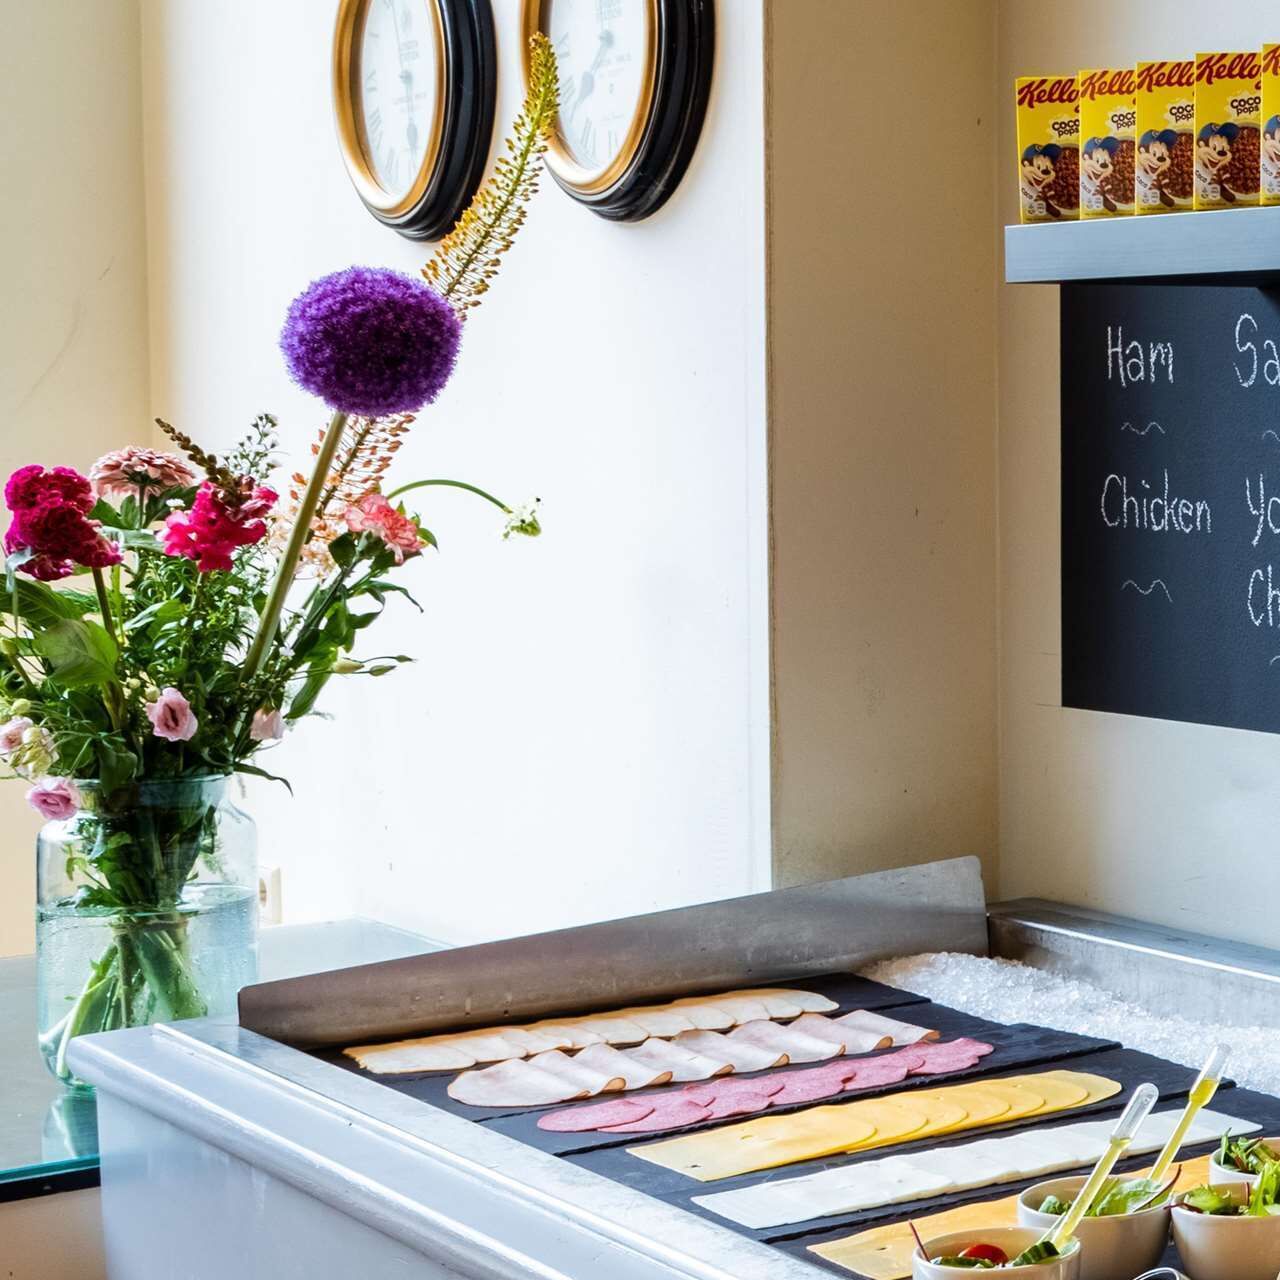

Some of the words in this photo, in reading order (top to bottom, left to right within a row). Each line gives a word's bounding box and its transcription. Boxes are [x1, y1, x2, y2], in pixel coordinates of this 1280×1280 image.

[1237, 104, 1260, 116] pops
[1107, 326, 1174, 387] Ham
[1101, 468, 1212, 533] Chicken
